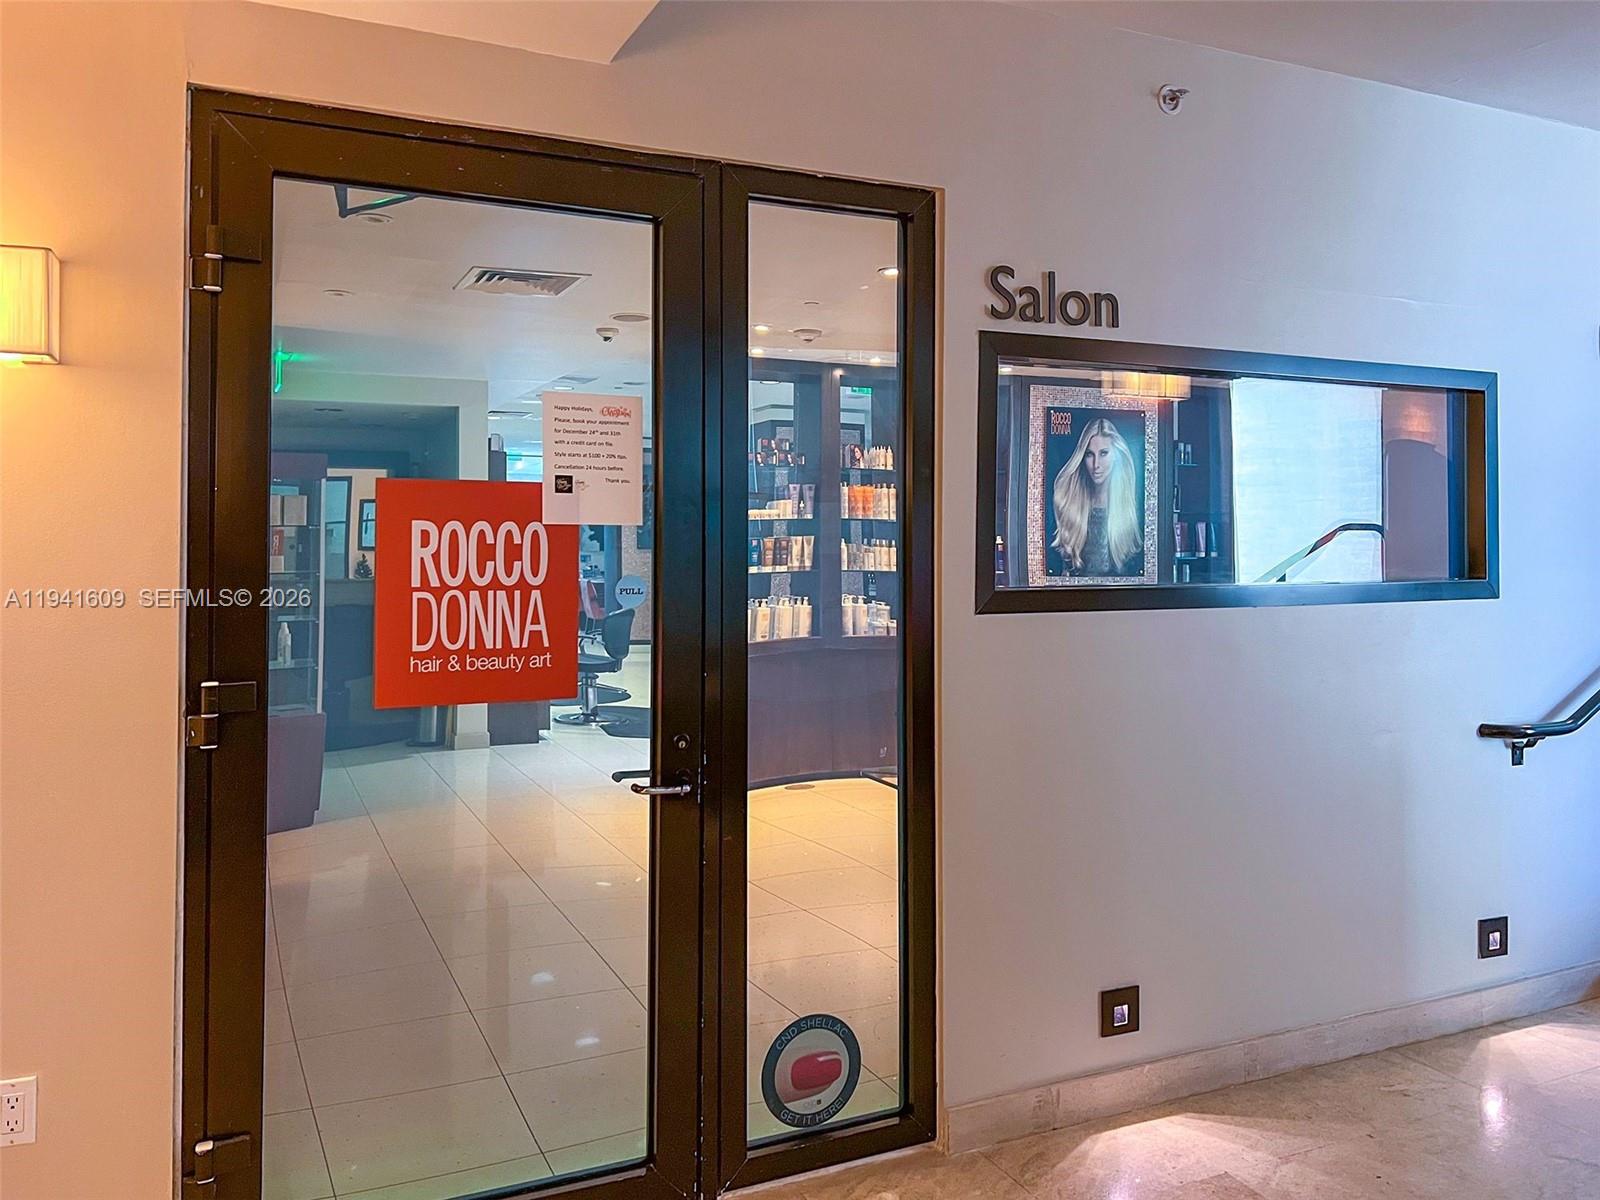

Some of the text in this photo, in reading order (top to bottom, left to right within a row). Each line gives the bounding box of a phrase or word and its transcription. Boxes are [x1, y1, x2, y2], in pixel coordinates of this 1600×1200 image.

[988, 265, 1120, 328] Salon
[1051, 412, 1072, 424] ROCCO
[1051, 424, 1072, 435] DONNA
[411, 520, 549, 588] ROCCO
[411, 589, 550, 653] DONNA
[410, 652, 552, 673] hair & beauty art
[776, 1017, 849, 1050] CND SHELLAC
[781, 1109, 799, 1124] GET
[802, 1115, 812, 1125] IT
[816, 1097, 845, 1123] HERE!
